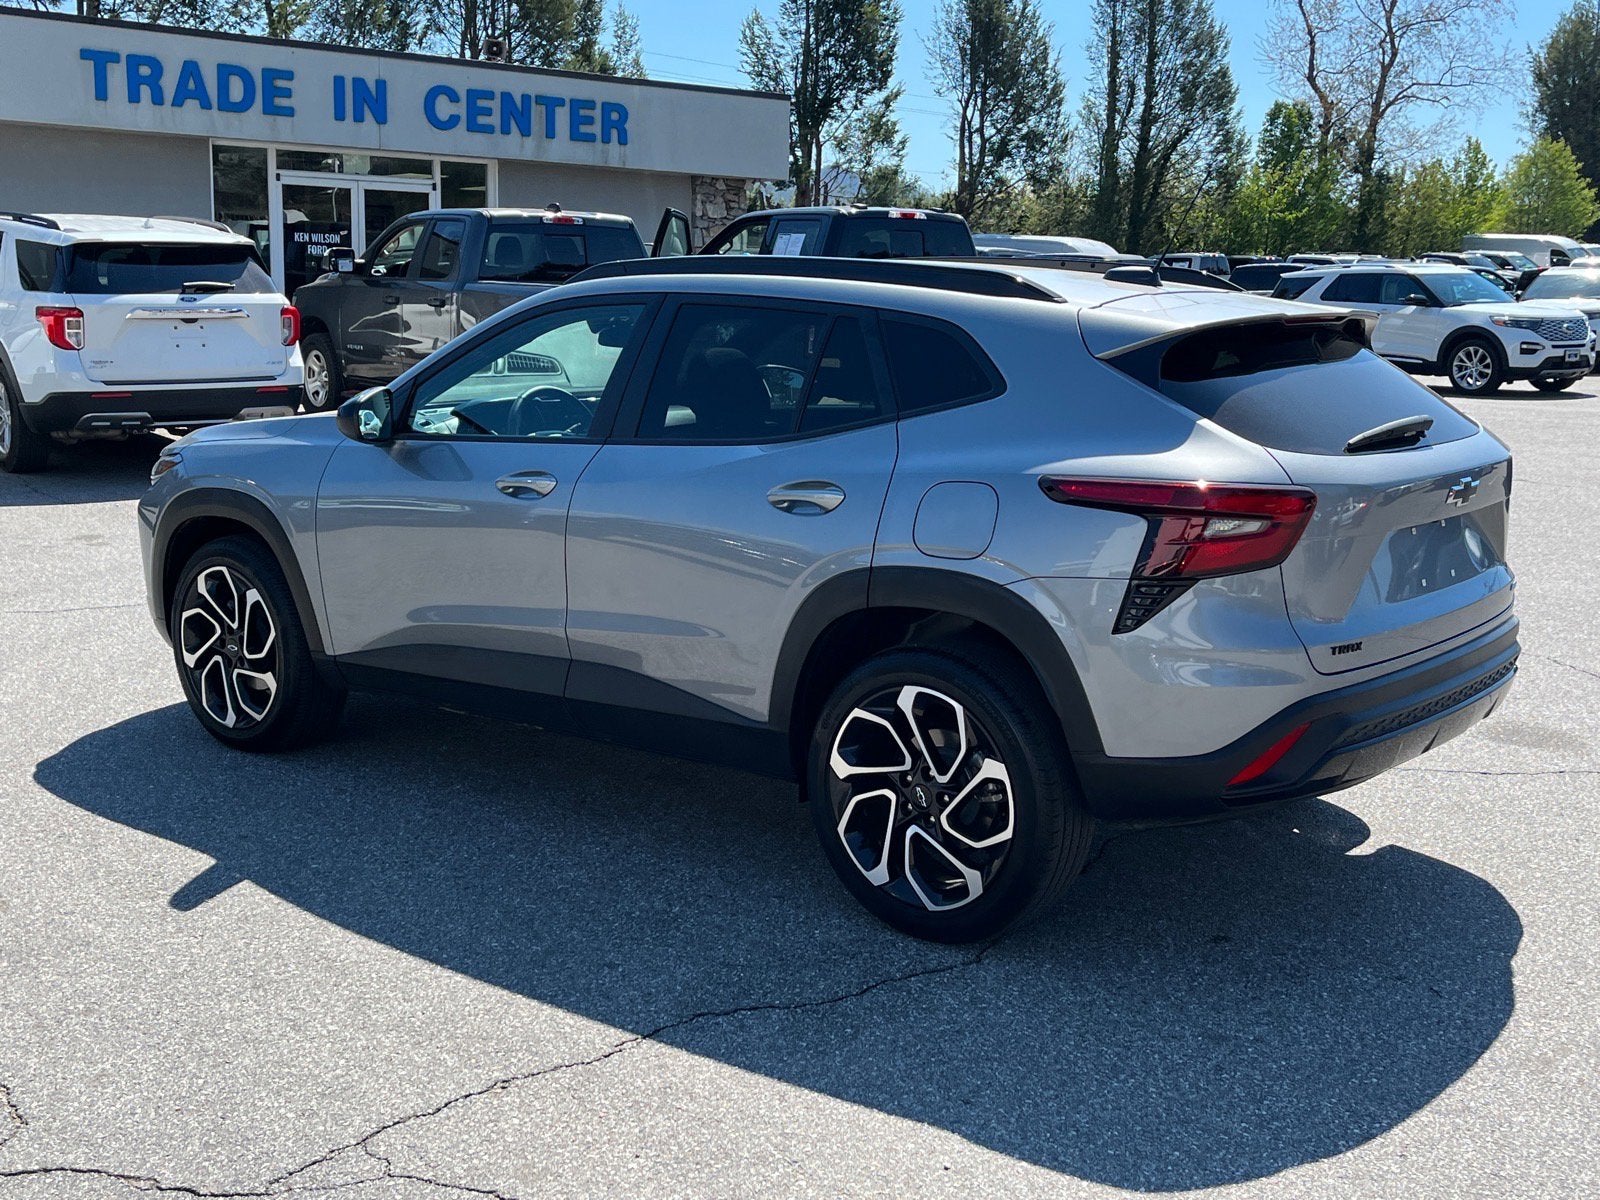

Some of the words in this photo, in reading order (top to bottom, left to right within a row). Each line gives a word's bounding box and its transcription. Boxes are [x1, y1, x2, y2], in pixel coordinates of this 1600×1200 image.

[79, 47, 296, 118] TRADE
[332, 74, 388, 125] IN
[423, 84, 630, 146] CENTER
[294, 231, 310, 243] KEN
[311, 232, 341, 244] WILSON
[307, 244, 328, 255] FORD
[1330, 641, 1363, 656] TRAX
